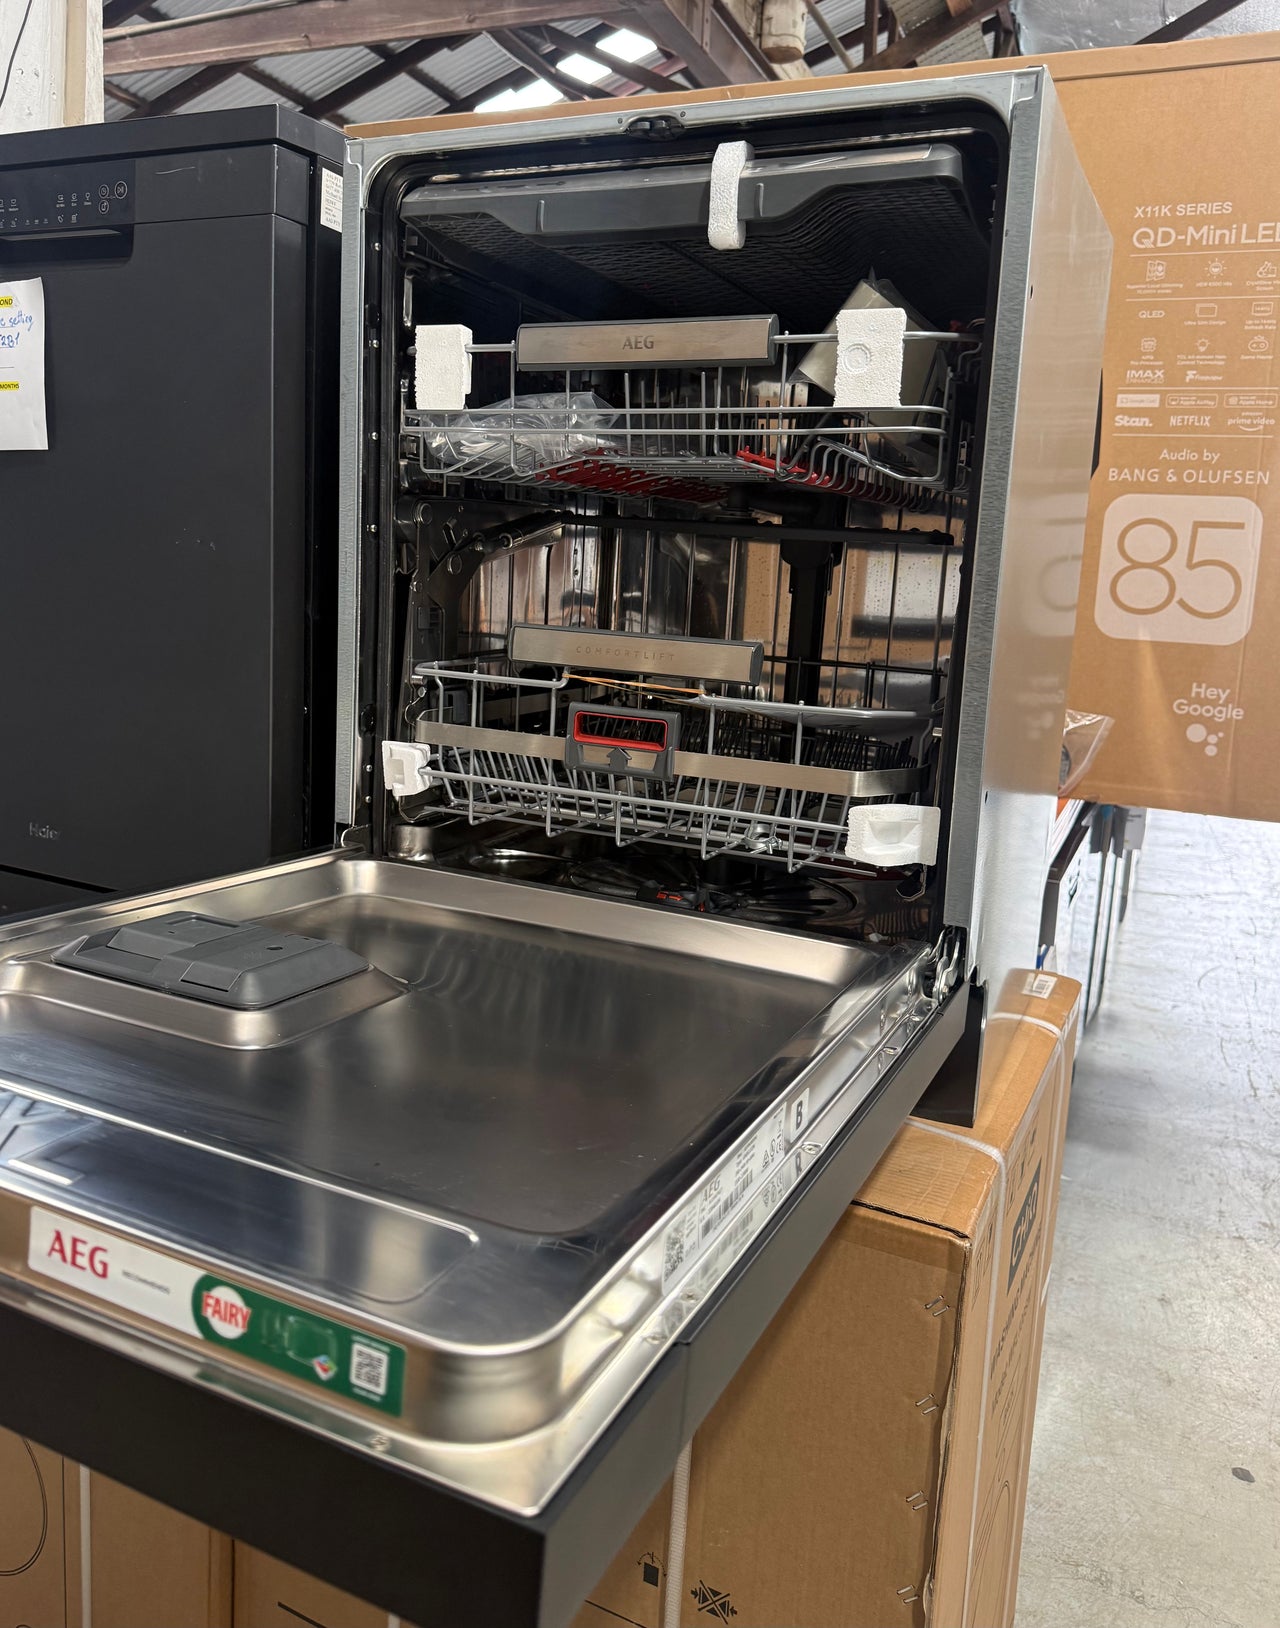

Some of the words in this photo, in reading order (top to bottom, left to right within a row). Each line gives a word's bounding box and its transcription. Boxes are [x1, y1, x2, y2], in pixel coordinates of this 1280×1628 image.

[1134, 205, 1172, 218] X11K
[1176, 201, 1233, 216] SERIES
[1132, 224, 1237, 249] QD-Mini
[1240, 222, 1280, 244] LE
[0, 332, 20, 348] 2B1
[622, 335, 655, 350] AEG
[1127, 369, 1165, 378] IMAX
[1114, 415, 1153, 427] Stan.
[1169, 416, 1211, 427] NETFLIX
[1228, 417, 1251, 425] prime
[1253, 417, 1275, 425] video
[1159, 448, 1198, 461] Audio
[1203, 448, 1220, 465] by
[1108, 468, 1160, 483] BANG
[1166, 469, 1178, 483] &
[1182, 469, 1270, 485] OLUFSEN
[1109, 517, 1245, 619] 85
[575, 645, 677, 662] COMFORTLIFT
[1191, 683, 1231, 704] Hey
[1172, 699, 1245, 721] Google
[47, 1230, 109, 1280] AEG
[200, 1291, 253, 1334] FAIRY
